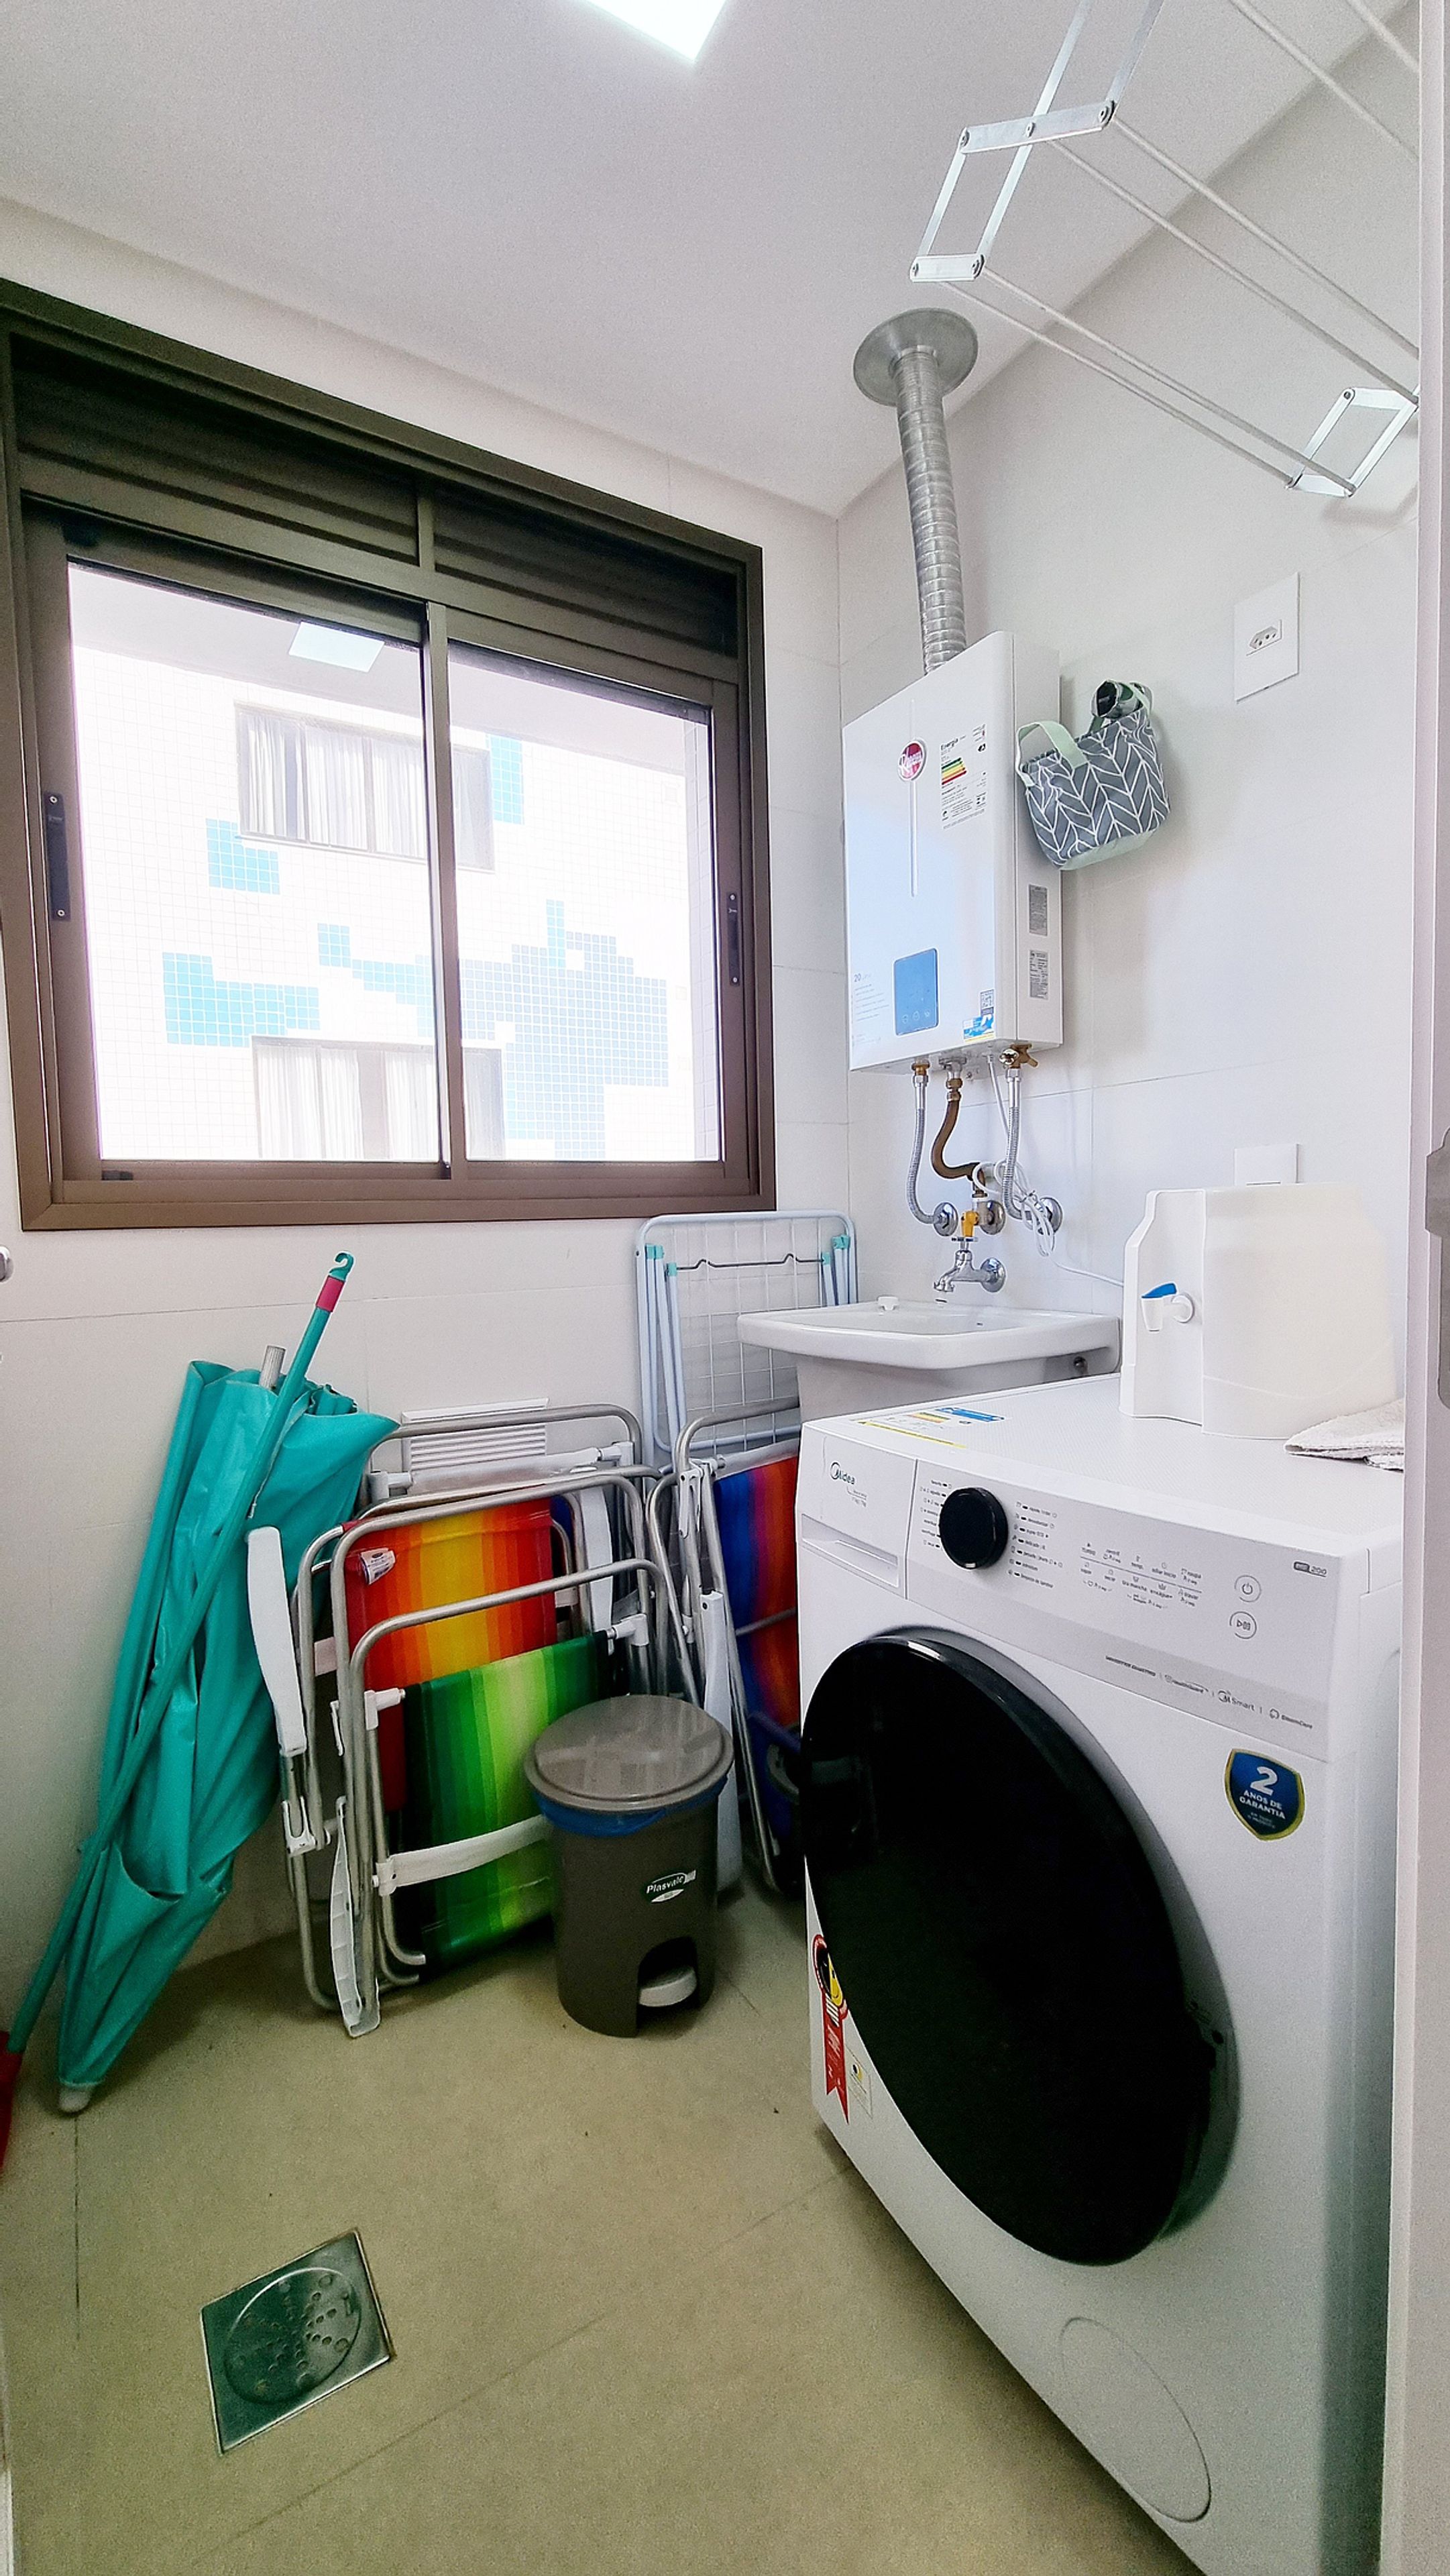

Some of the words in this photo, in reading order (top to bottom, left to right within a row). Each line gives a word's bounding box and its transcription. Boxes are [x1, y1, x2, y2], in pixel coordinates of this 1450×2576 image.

[830, 1462, 855, 1485] Midea
[1249, 1766, 1278, 1796] 2
[1239, 1796, 1286, 1820] GARANTIA
[1243, 1790, 1268, 1805] ANOS
[1270, 1799, 1282, 1811] DE
